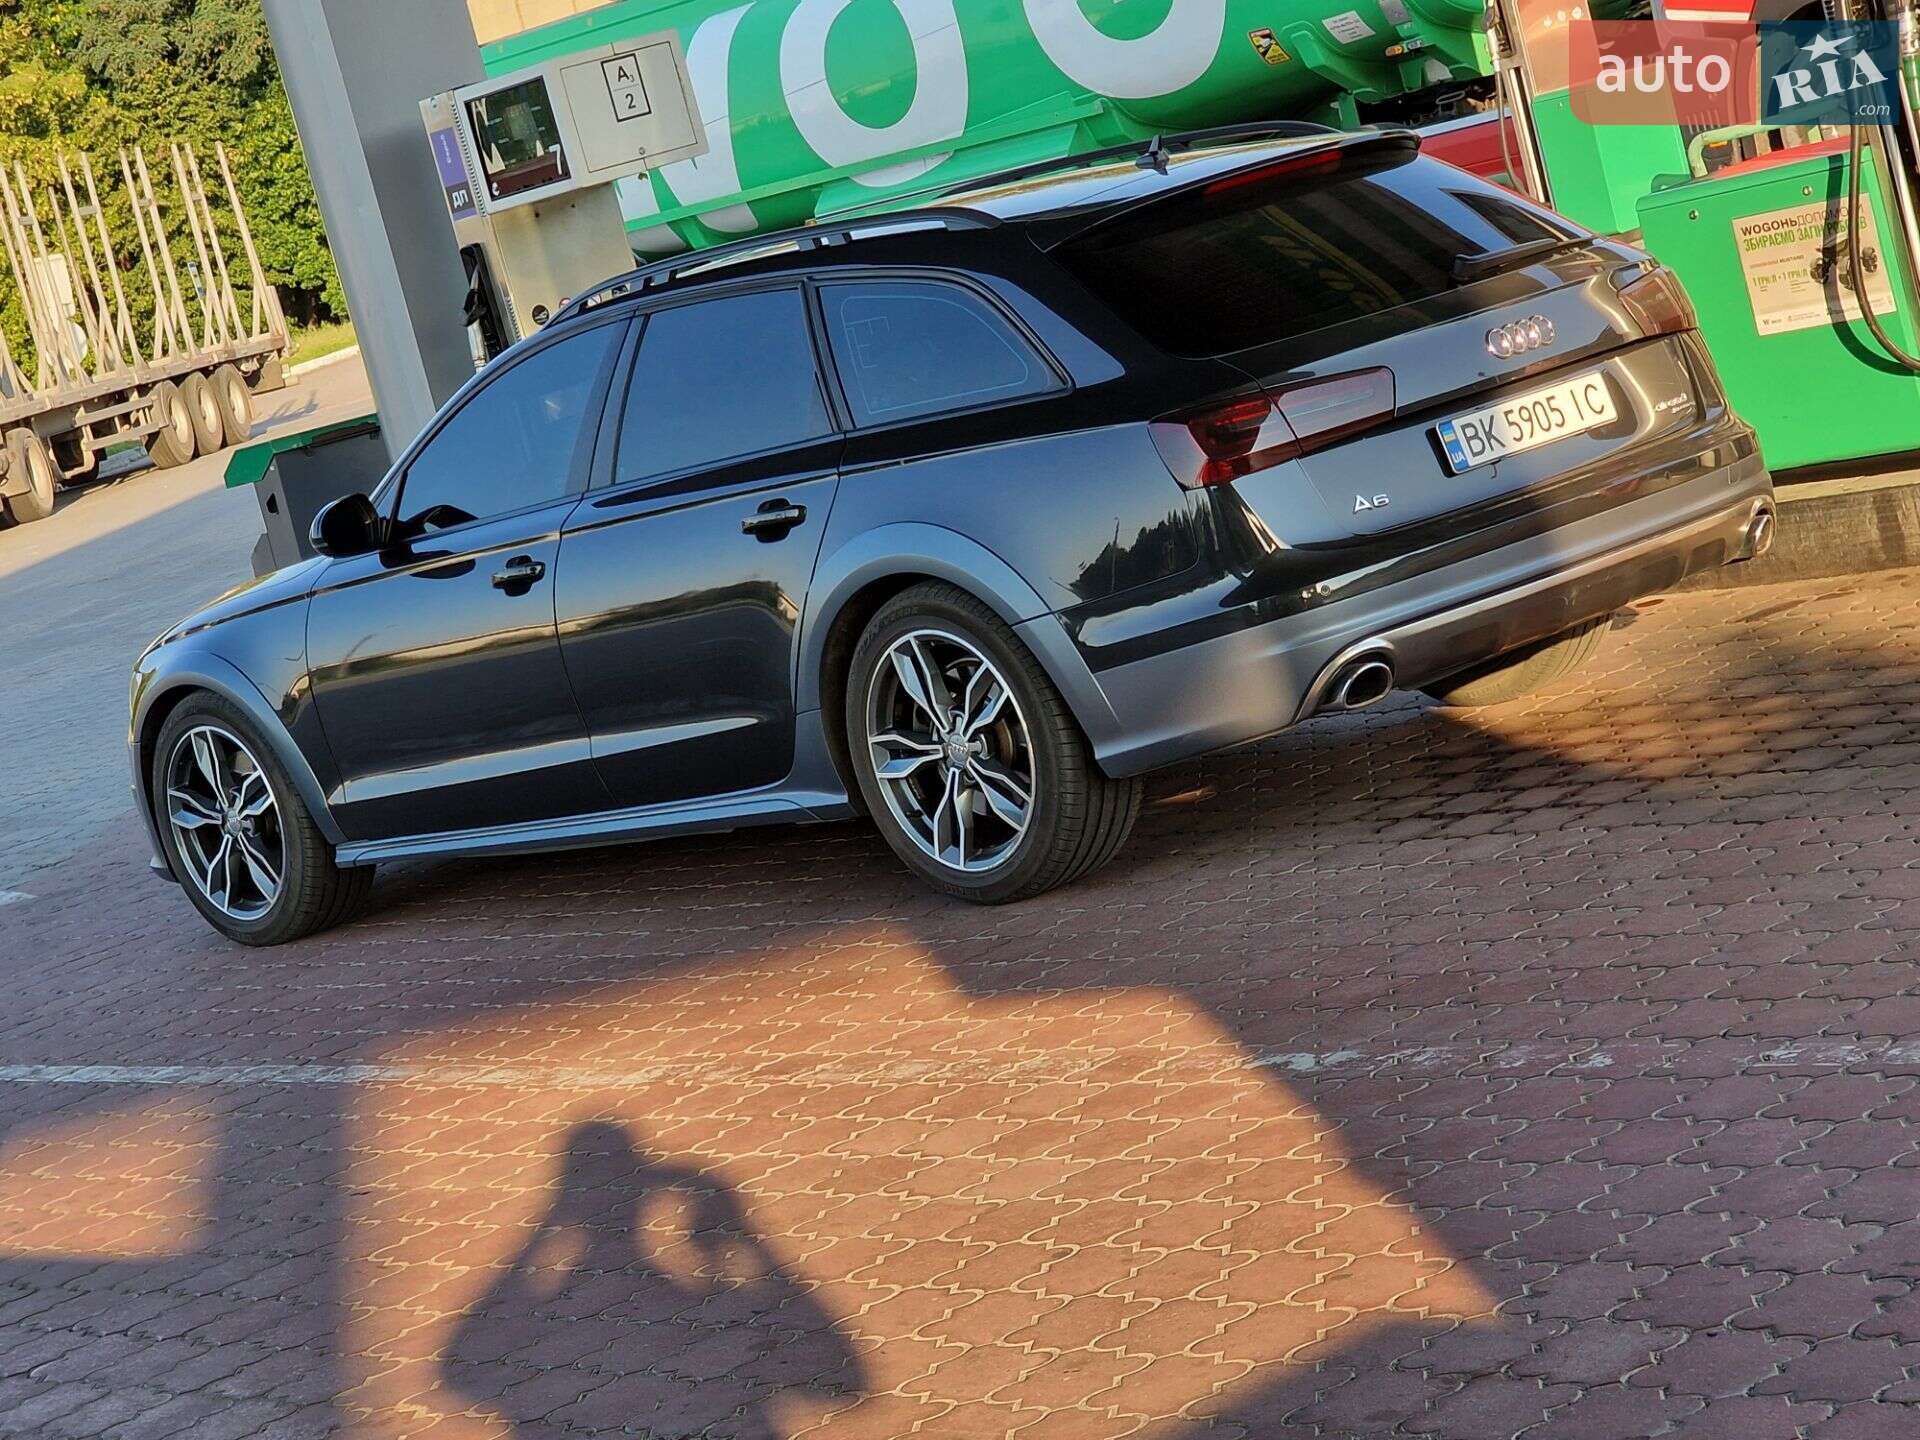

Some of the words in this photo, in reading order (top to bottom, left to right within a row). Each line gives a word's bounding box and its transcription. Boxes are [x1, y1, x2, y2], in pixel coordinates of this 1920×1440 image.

[625, 93, 636, 109] 2
[452, 189, 469, 208] ДП
[1743, 230, 1796, 252] ЗБИРАЄМО
[1460, 414, 1506, 458] BK
[1503, 396, 1565, 443] 5905
[1570, 384, 1605, 421] IC
[1452, 453, 1466, 464] UA
[1353, 494, 1390, 513] A6
